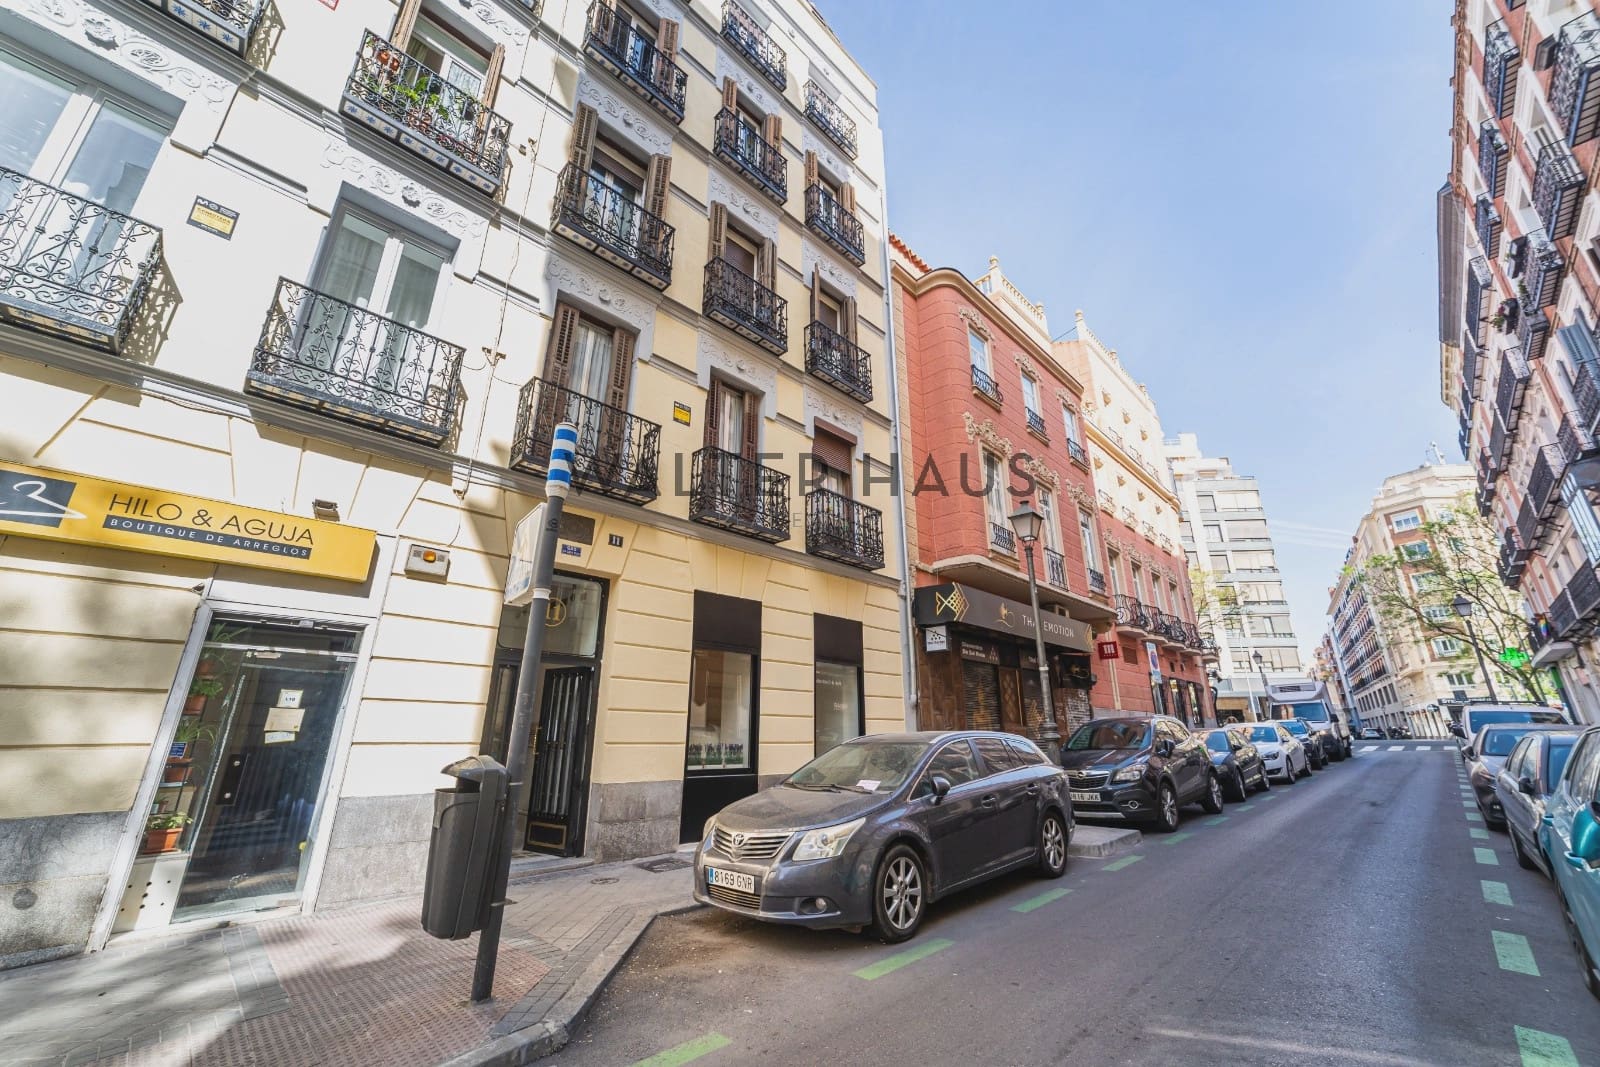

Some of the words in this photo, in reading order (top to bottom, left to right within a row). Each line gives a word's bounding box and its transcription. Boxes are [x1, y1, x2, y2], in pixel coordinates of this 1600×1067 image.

[108, 493, 183, 521] HILO
[191, 509, 212, 528] &
[220, 515, 315, 545] AGUJA
[110, 518, 197, 539] BOUTIQUE
[205, 533, 225, 544] DE
[232, 538, 309, 557] ARREGLOS
[612, 535, 620, 546] 11
[1043, 620, 1075, 638] EMOTION
[714, 871, 735, 886] 8169
